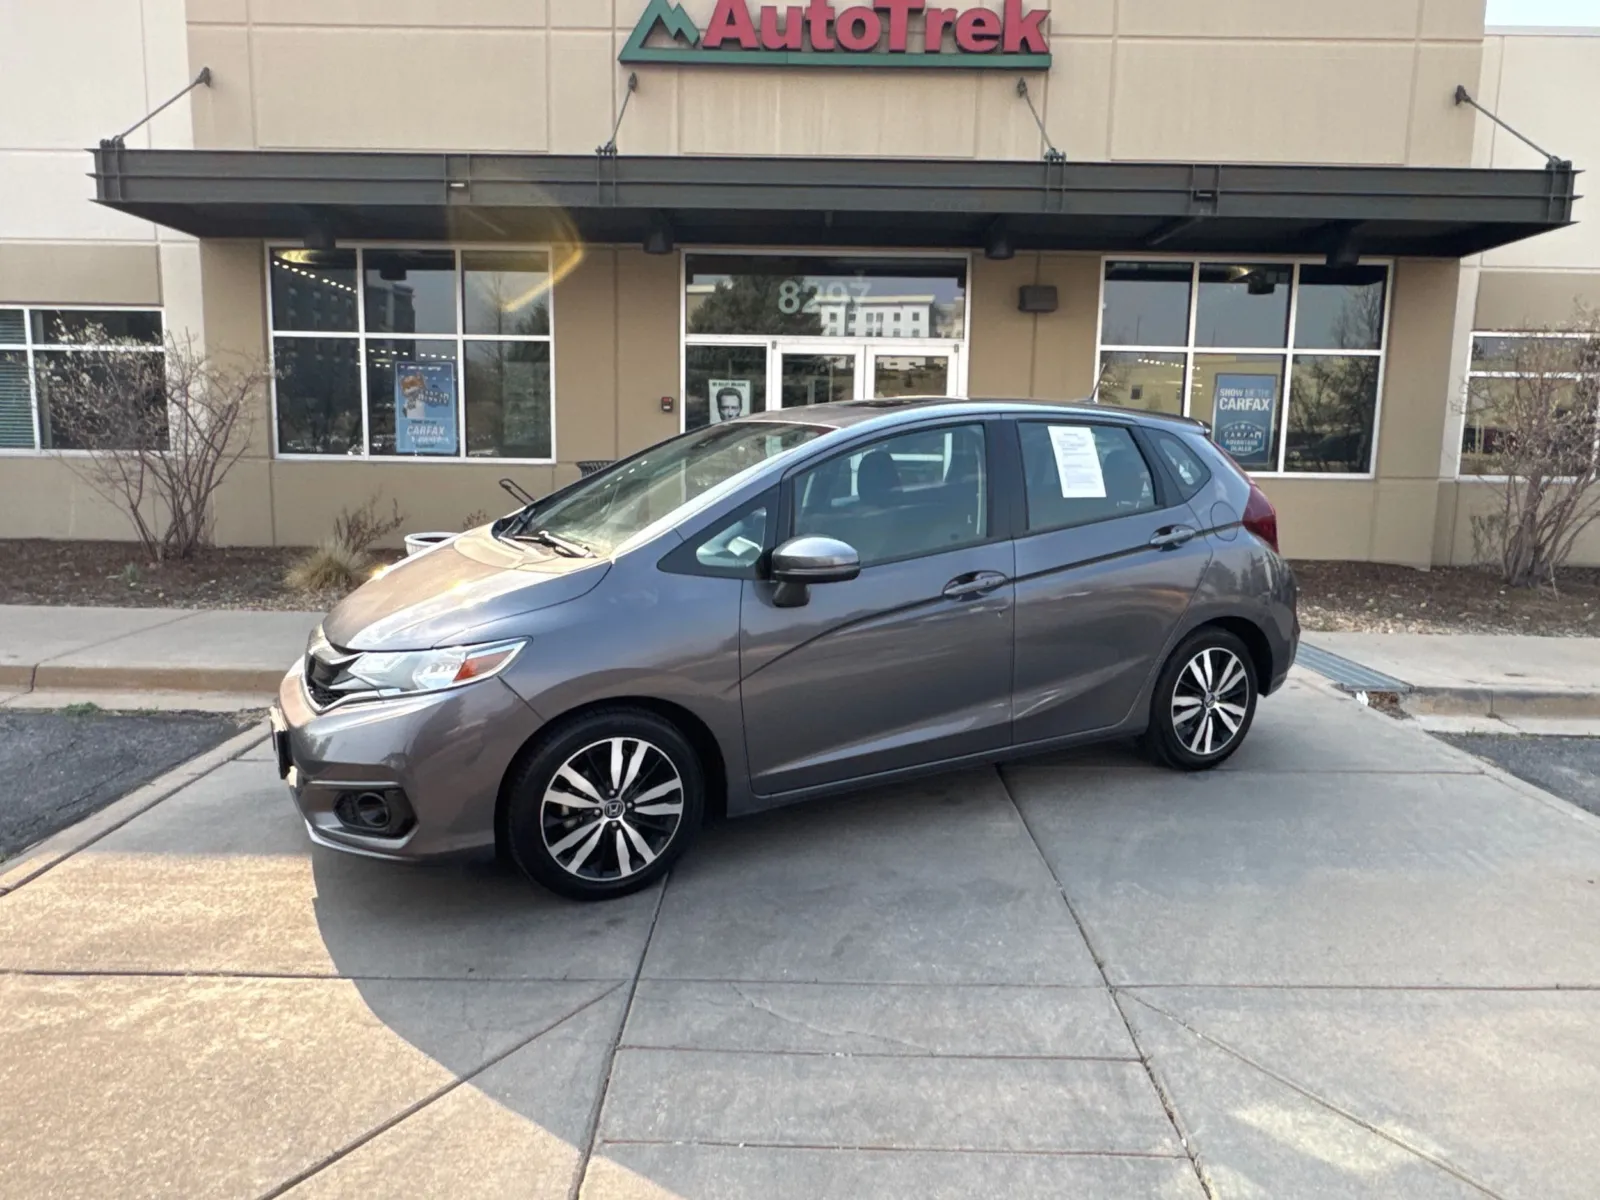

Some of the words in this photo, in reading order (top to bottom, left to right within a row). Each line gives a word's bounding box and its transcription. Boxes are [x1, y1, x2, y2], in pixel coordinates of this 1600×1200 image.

[702, 0, 1051, 53] AutoTrek
[778, 280, 872, 314] 8297
[1219, 388, 1243, 397] SHOW
[1219, 397, 1270, 411] CARFAX
[406, 425, 445, 436] CARFAX
